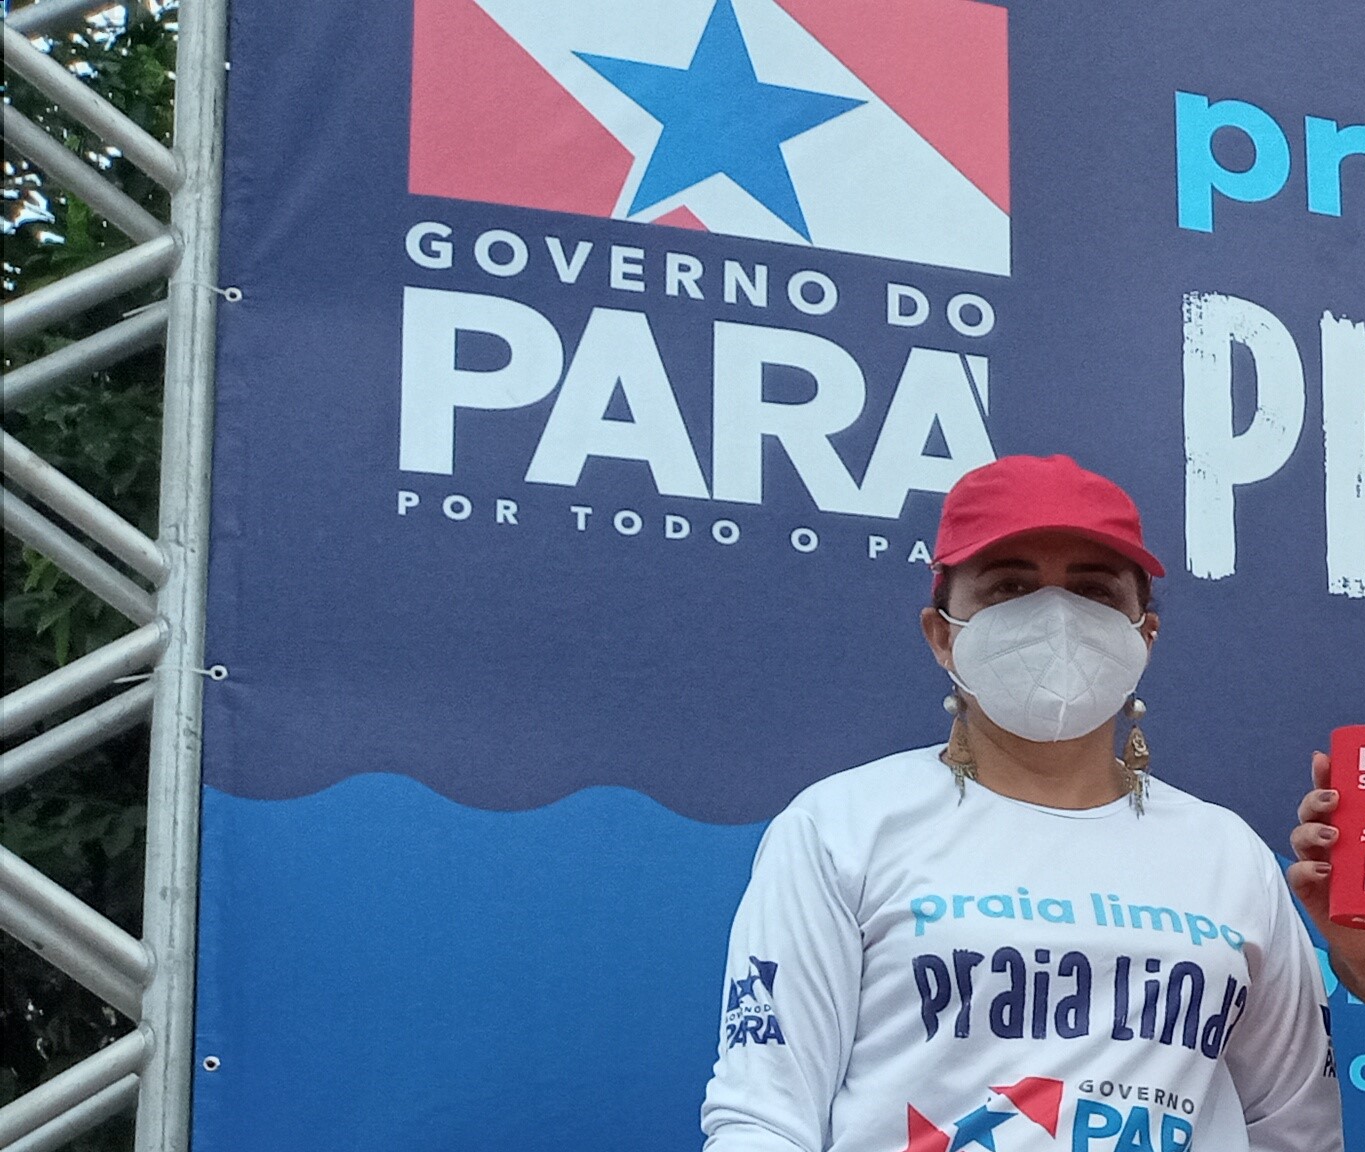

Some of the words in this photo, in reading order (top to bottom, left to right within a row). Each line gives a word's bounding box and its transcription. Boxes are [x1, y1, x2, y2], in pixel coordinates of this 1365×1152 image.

[404, 221, 838, 315] GOVERNO
[887, 282, 996, 337] DO
[398, 491, 519, 525] POR
[570, 504, 741, 546] TODO
[791, 527, 819, 553] O
[869, 534, 932, 566] PA
[910, 886, 1076, 938] praia
[1078, 1079, 1195, 1115] GOVERNO
